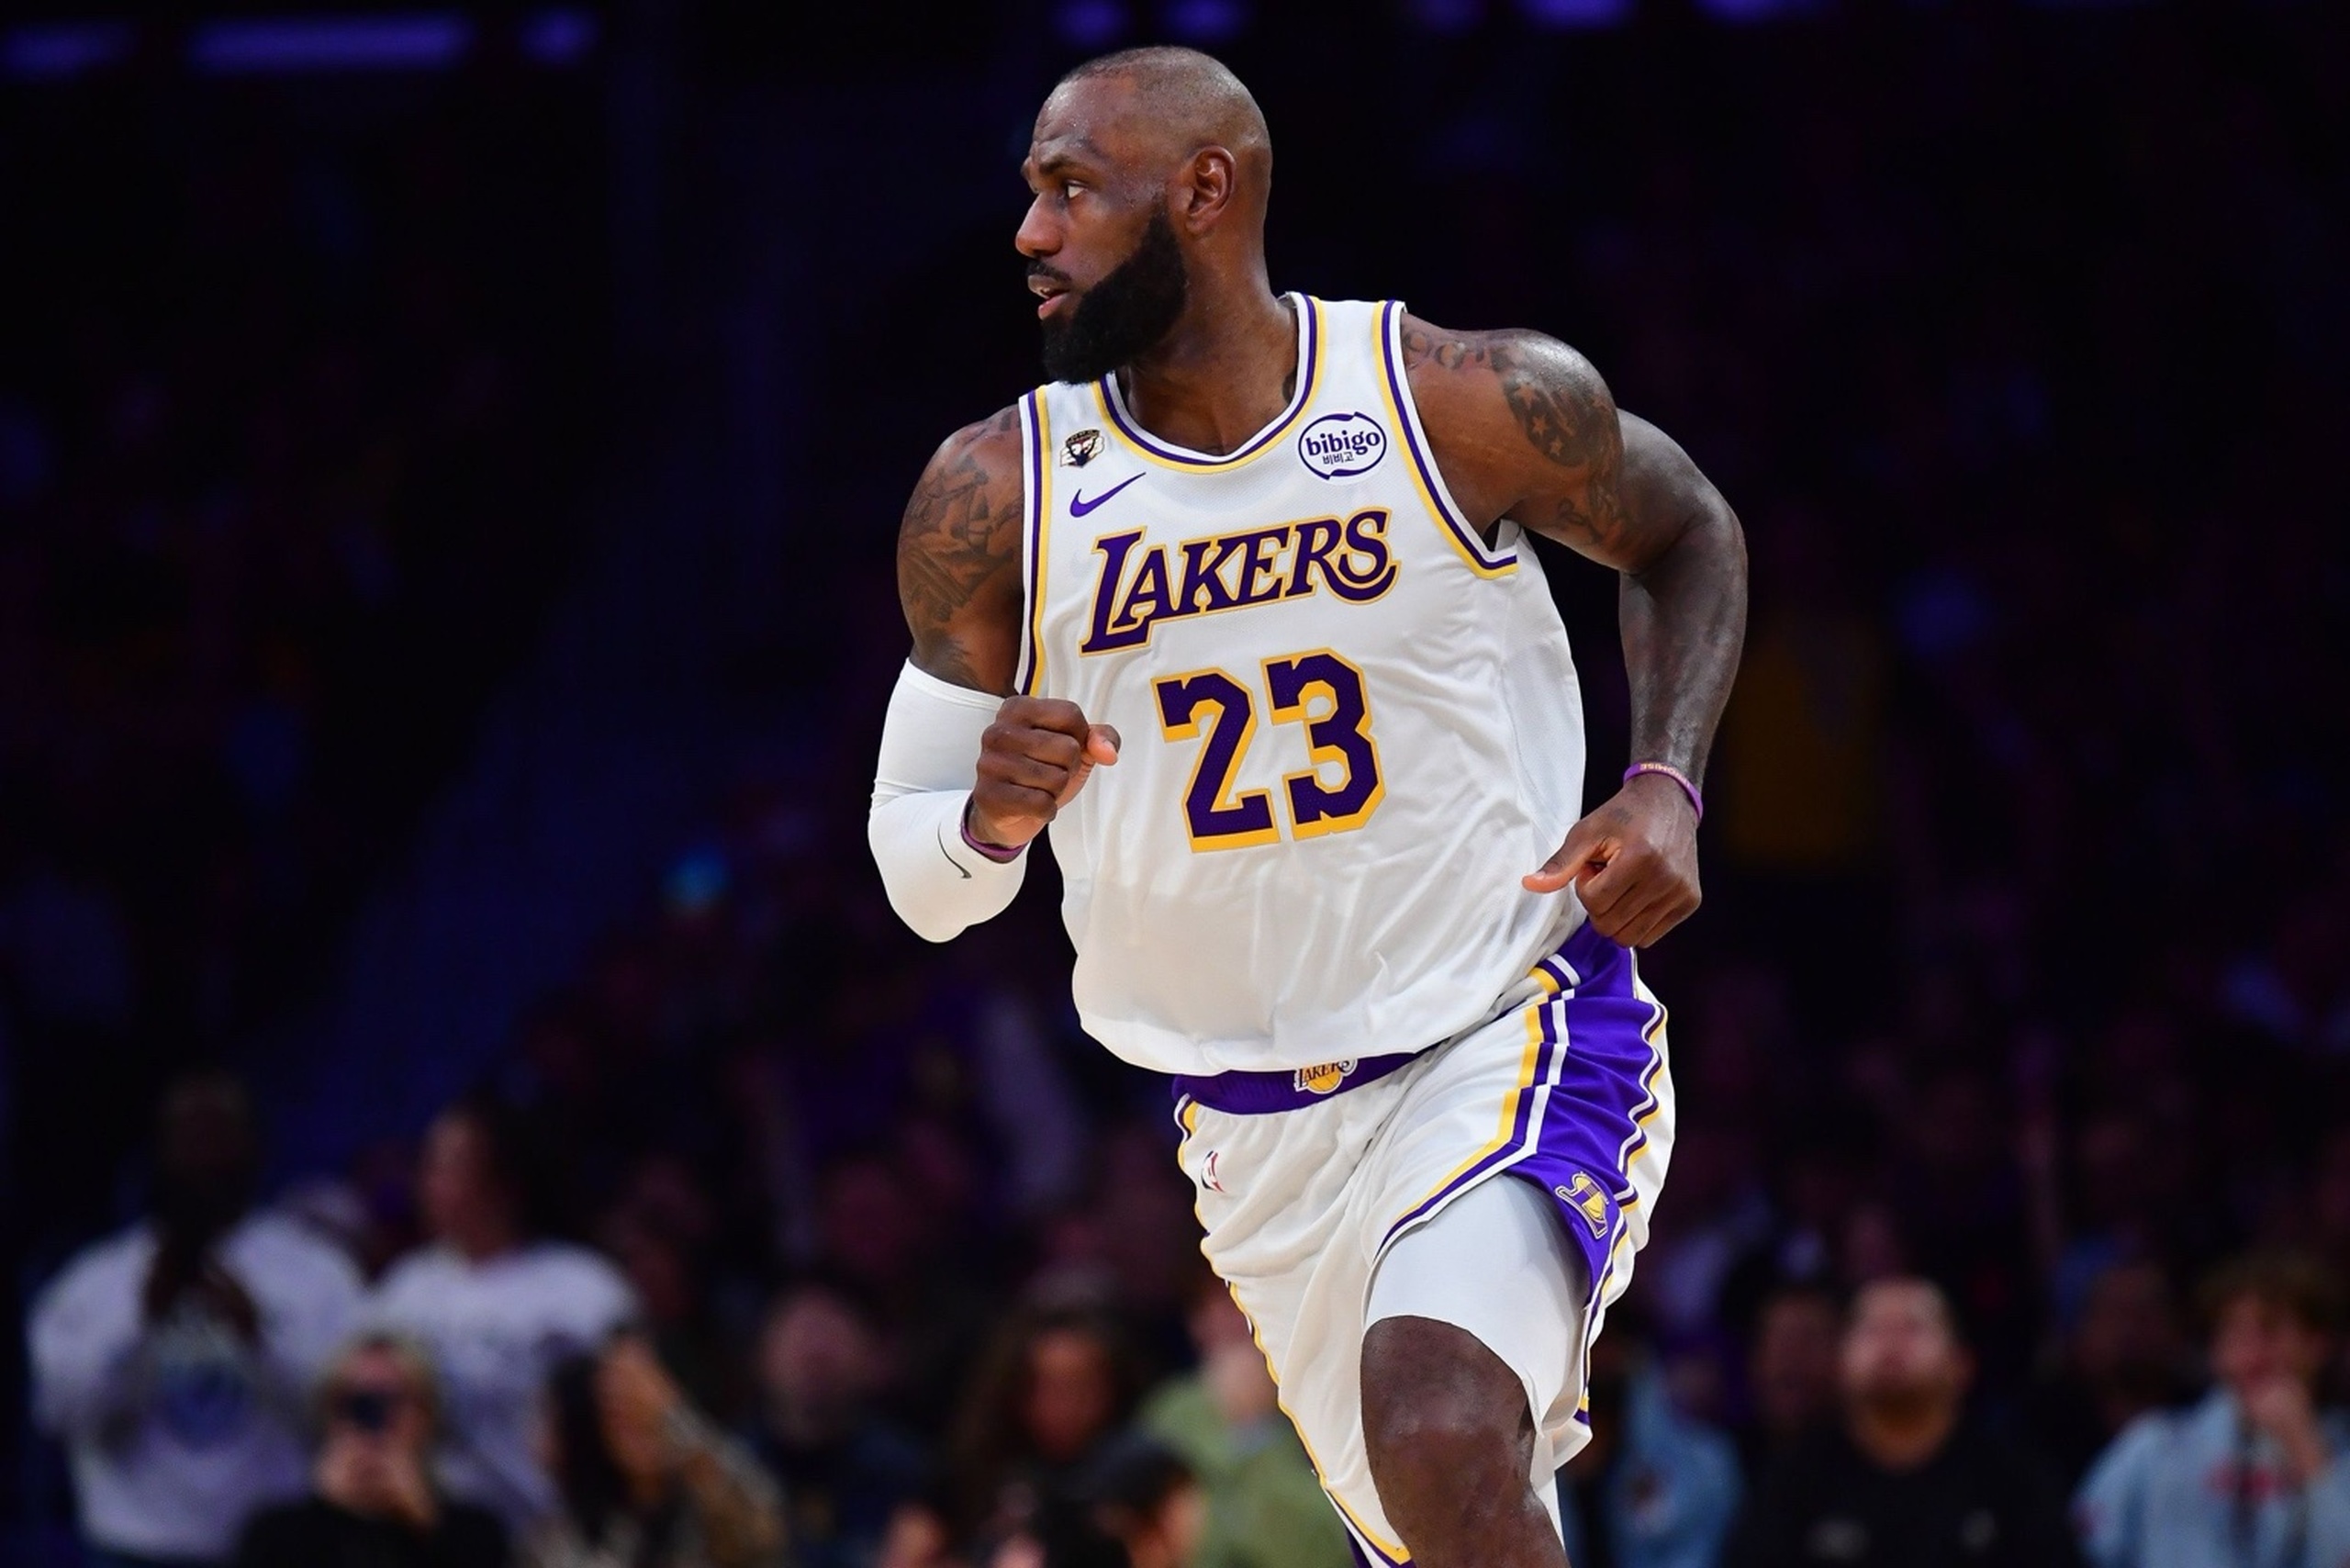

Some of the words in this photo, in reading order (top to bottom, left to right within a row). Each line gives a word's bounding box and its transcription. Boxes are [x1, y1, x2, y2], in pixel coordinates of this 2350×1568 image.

[1305, 430, 1381, 455] bibigo
[1322, 452, 1355, 465] 비비고
[1079, 506, 1402, 657] LAKERS
[1150, 646, 1387, 854] 23
